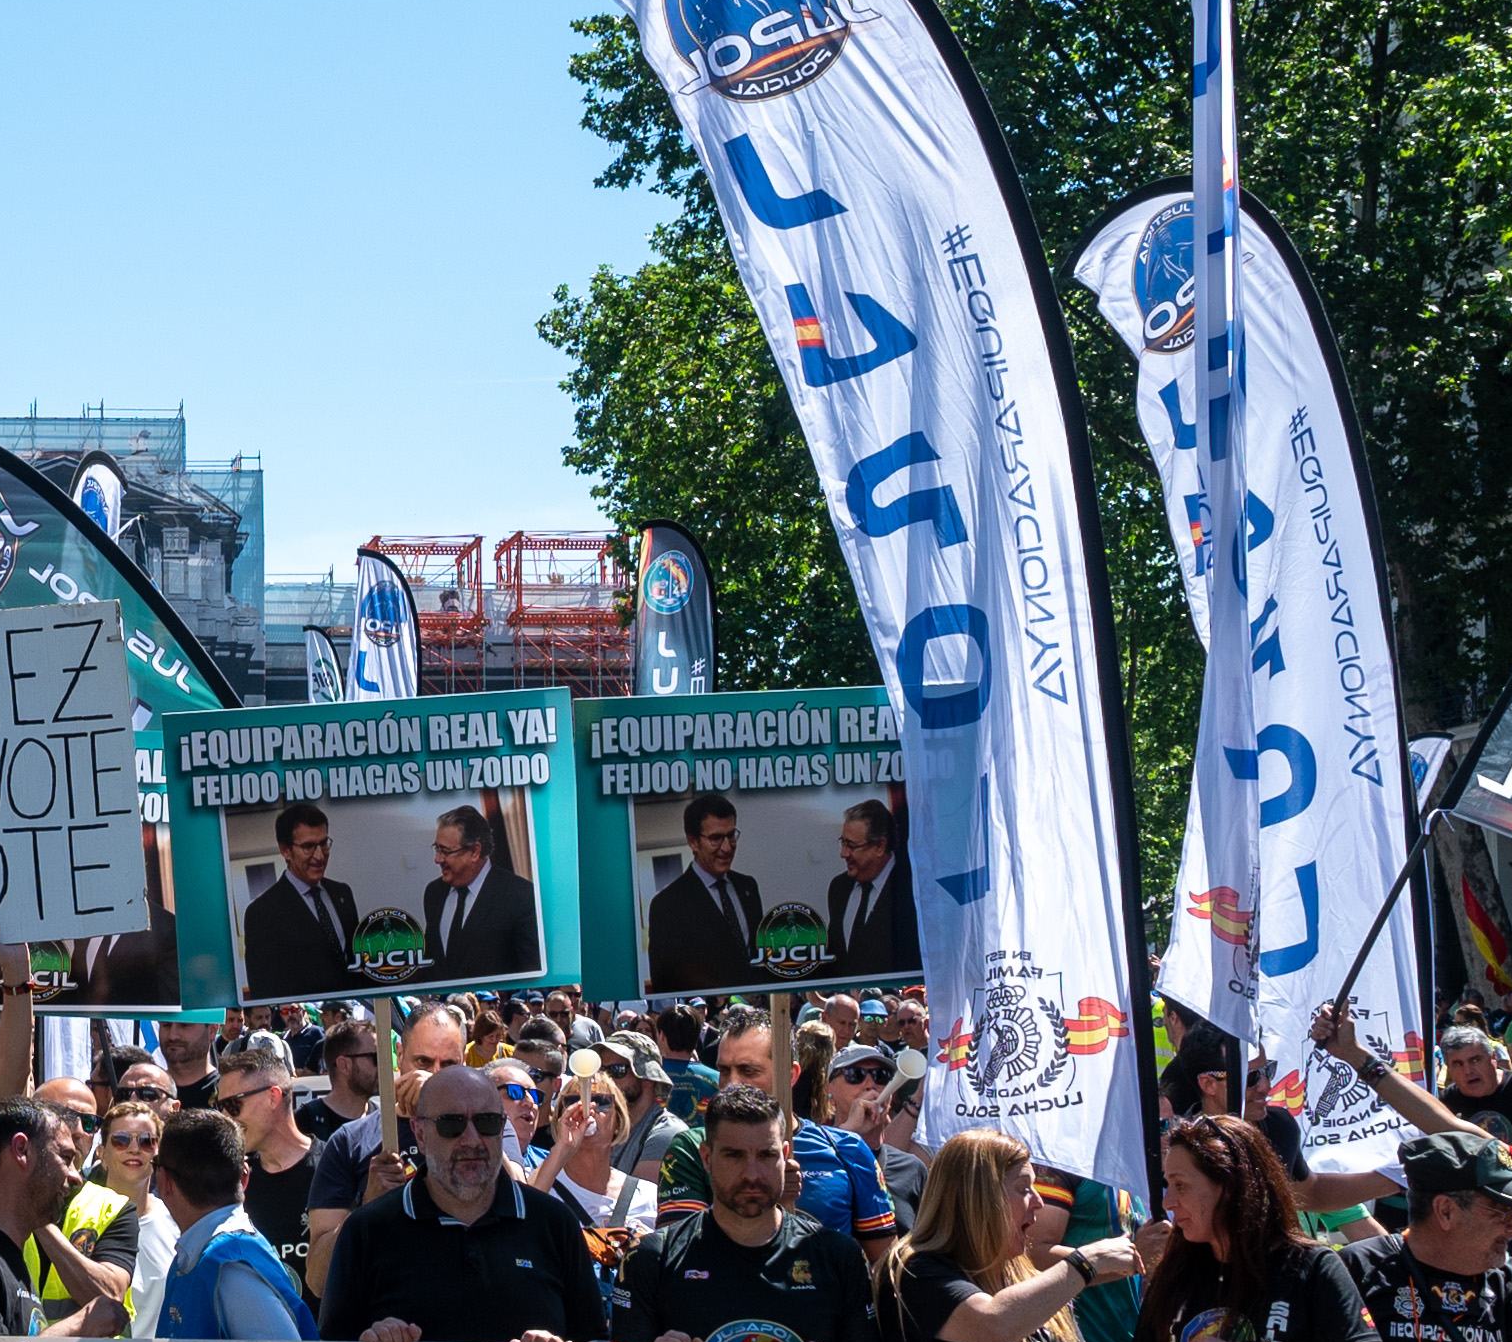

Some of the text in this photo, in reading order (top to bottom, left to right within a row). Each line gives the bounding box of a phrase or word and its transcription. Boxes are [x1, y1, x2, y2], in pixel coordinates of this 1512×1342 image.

[180, 706, 558, 772] ¡EQUIPARACIÓN REAL YA!
[590, 701, 831, 759] ¡EQUIPARACIÓN
[192, 752, 551, 808] FEIJOO NO HAGAS UN ZOIDO
[602, 759, 690, 796] FEIJOO
[695, 757, 732, 792] NO
[739, 754, 829, 790] HAGAS
[834, 752, 872, 785] UN
[347, 948, 436, 973] JUCIL
[750, 944, 837, 967] JUCIL
